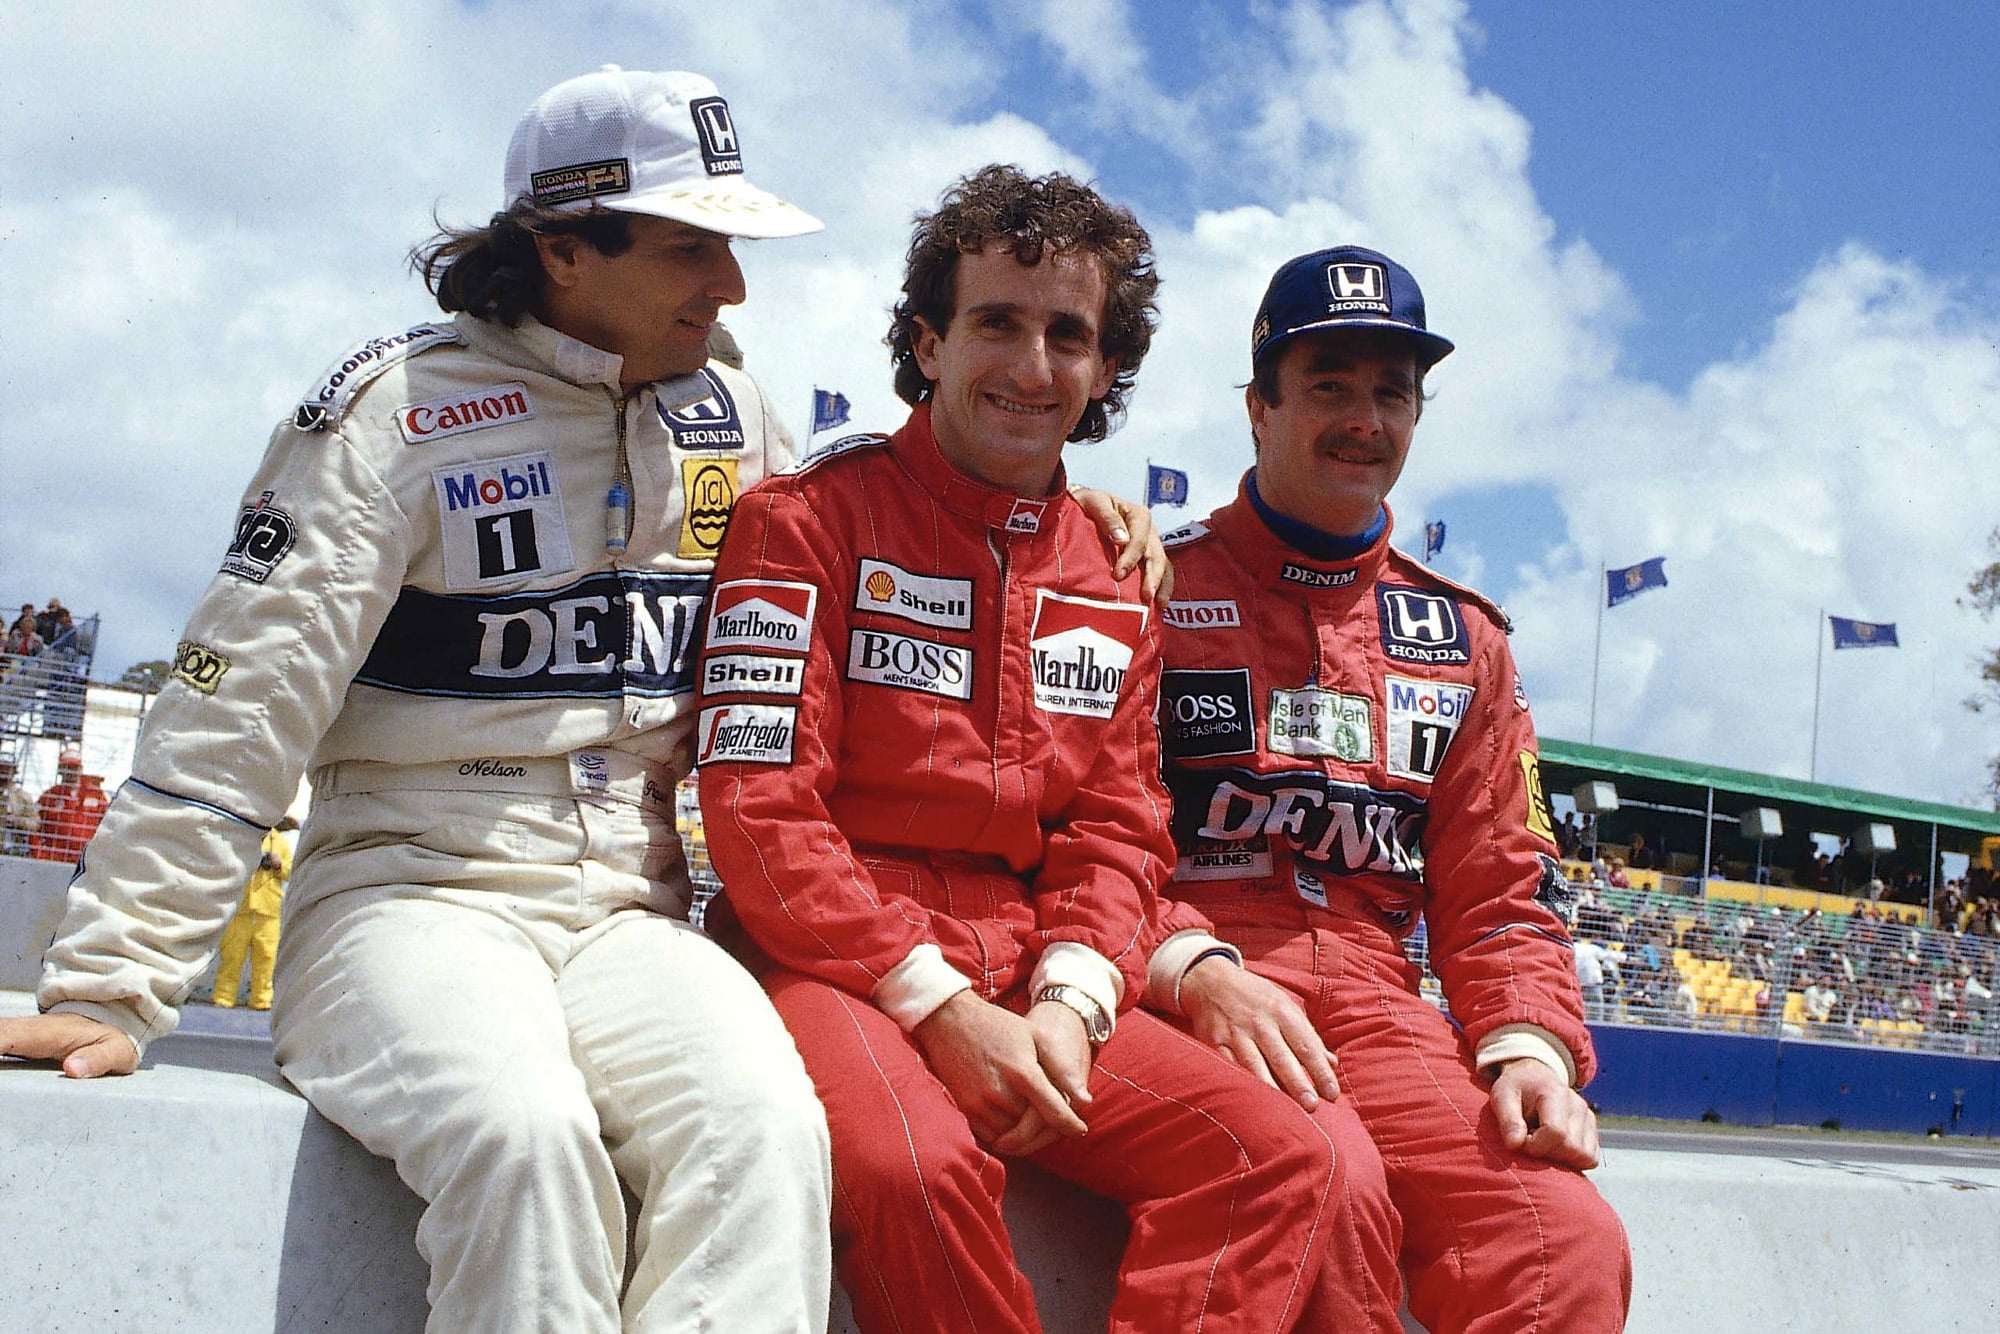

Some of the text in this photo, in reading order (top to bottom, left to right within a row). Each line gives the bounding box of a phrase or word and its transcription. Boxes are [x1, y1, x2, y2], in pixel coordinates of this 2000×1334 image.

[537, 170, 584, 187] HONDA
[1328, 300, 1390, 313] HONDA
[406, 391, 528, 436] Canon
[680, 430, 743, 445] HONDA
[443, 461, 551, 512] Mobil
[702, 480, 723, 506] ICI
[491, 516, 516, 572] 1
[1283, 564, 1357, 586] DENIM
[900, 589, 965, 616] Shell
[714, 611, 798, 641] Marlboro
[858, 632, 963, 685] BOSS
[1387, 644, 1468, 661] HONDA
[709, 663, 795, 684] Shell
[883, 673, 940, 691] MEN'S FASHION
[1274, 696, 1366, 724] Isle of Man
[1392, 683, 1468, 722] Mobil
[699, 708, 790, 762] Segafredo
[1190, 721, 1242, 737] FASHION
[1274, 718, 1322, 738] Bank
[729, 748, 766, 758] ZANETTI
[1421, 727, 1436, 772] 1
[458, 760, 527, 777] Nelson
[1192, 853, 1251, 868] AIRLINES
